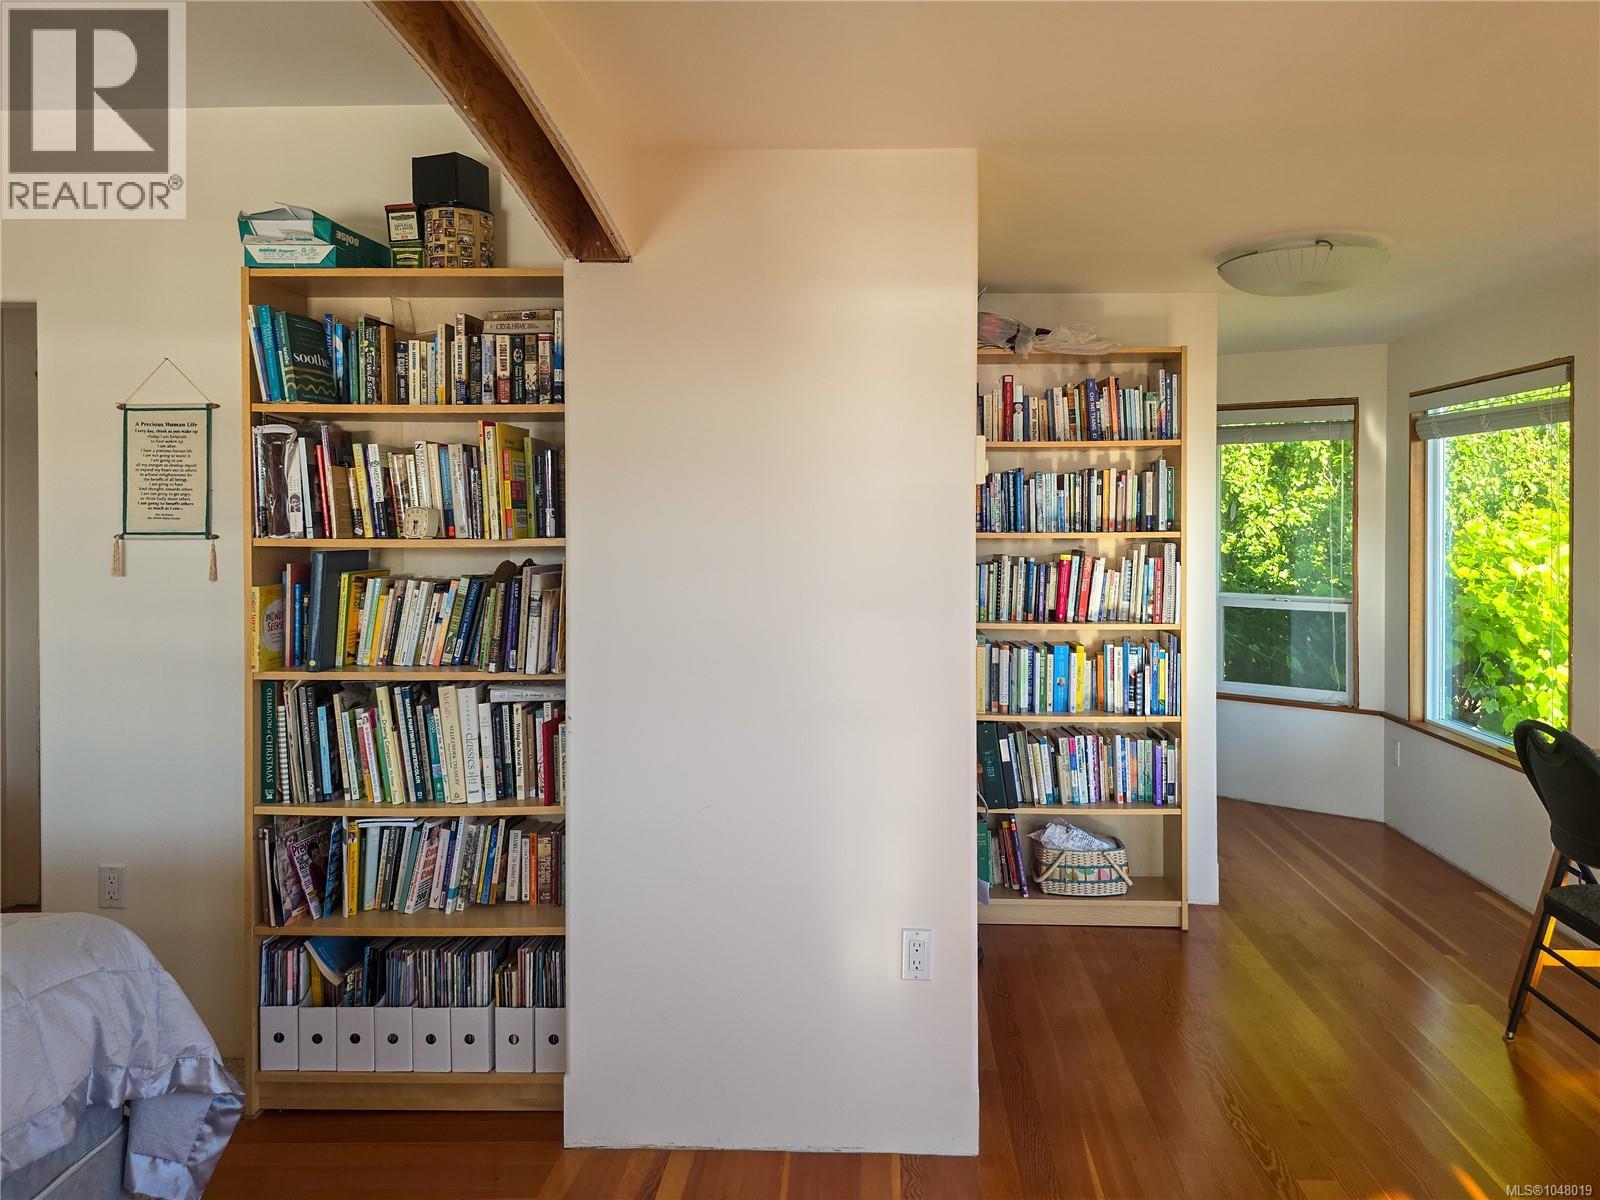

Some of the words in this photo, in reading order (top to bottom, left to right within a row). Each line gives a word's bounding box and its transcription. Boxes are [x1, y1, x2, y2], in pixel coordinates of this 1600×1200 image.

[293, 351, 330, 369] soothe
[366, 364, 375, 382] WILD
[372, 468, 383, 502] MEDITATION
[266, 687, 274, 729] CELEBRATION
[381, 719, 389, 740] Drawing
[265, 735, 274, 783] CHRISTMAS
[384, 740, 392, 769] Companion
[407, 719, 415, 742] PAINTING
[411, 748, 421, 784] WATERCOLOR
[464, 732, 478, 770] classics
